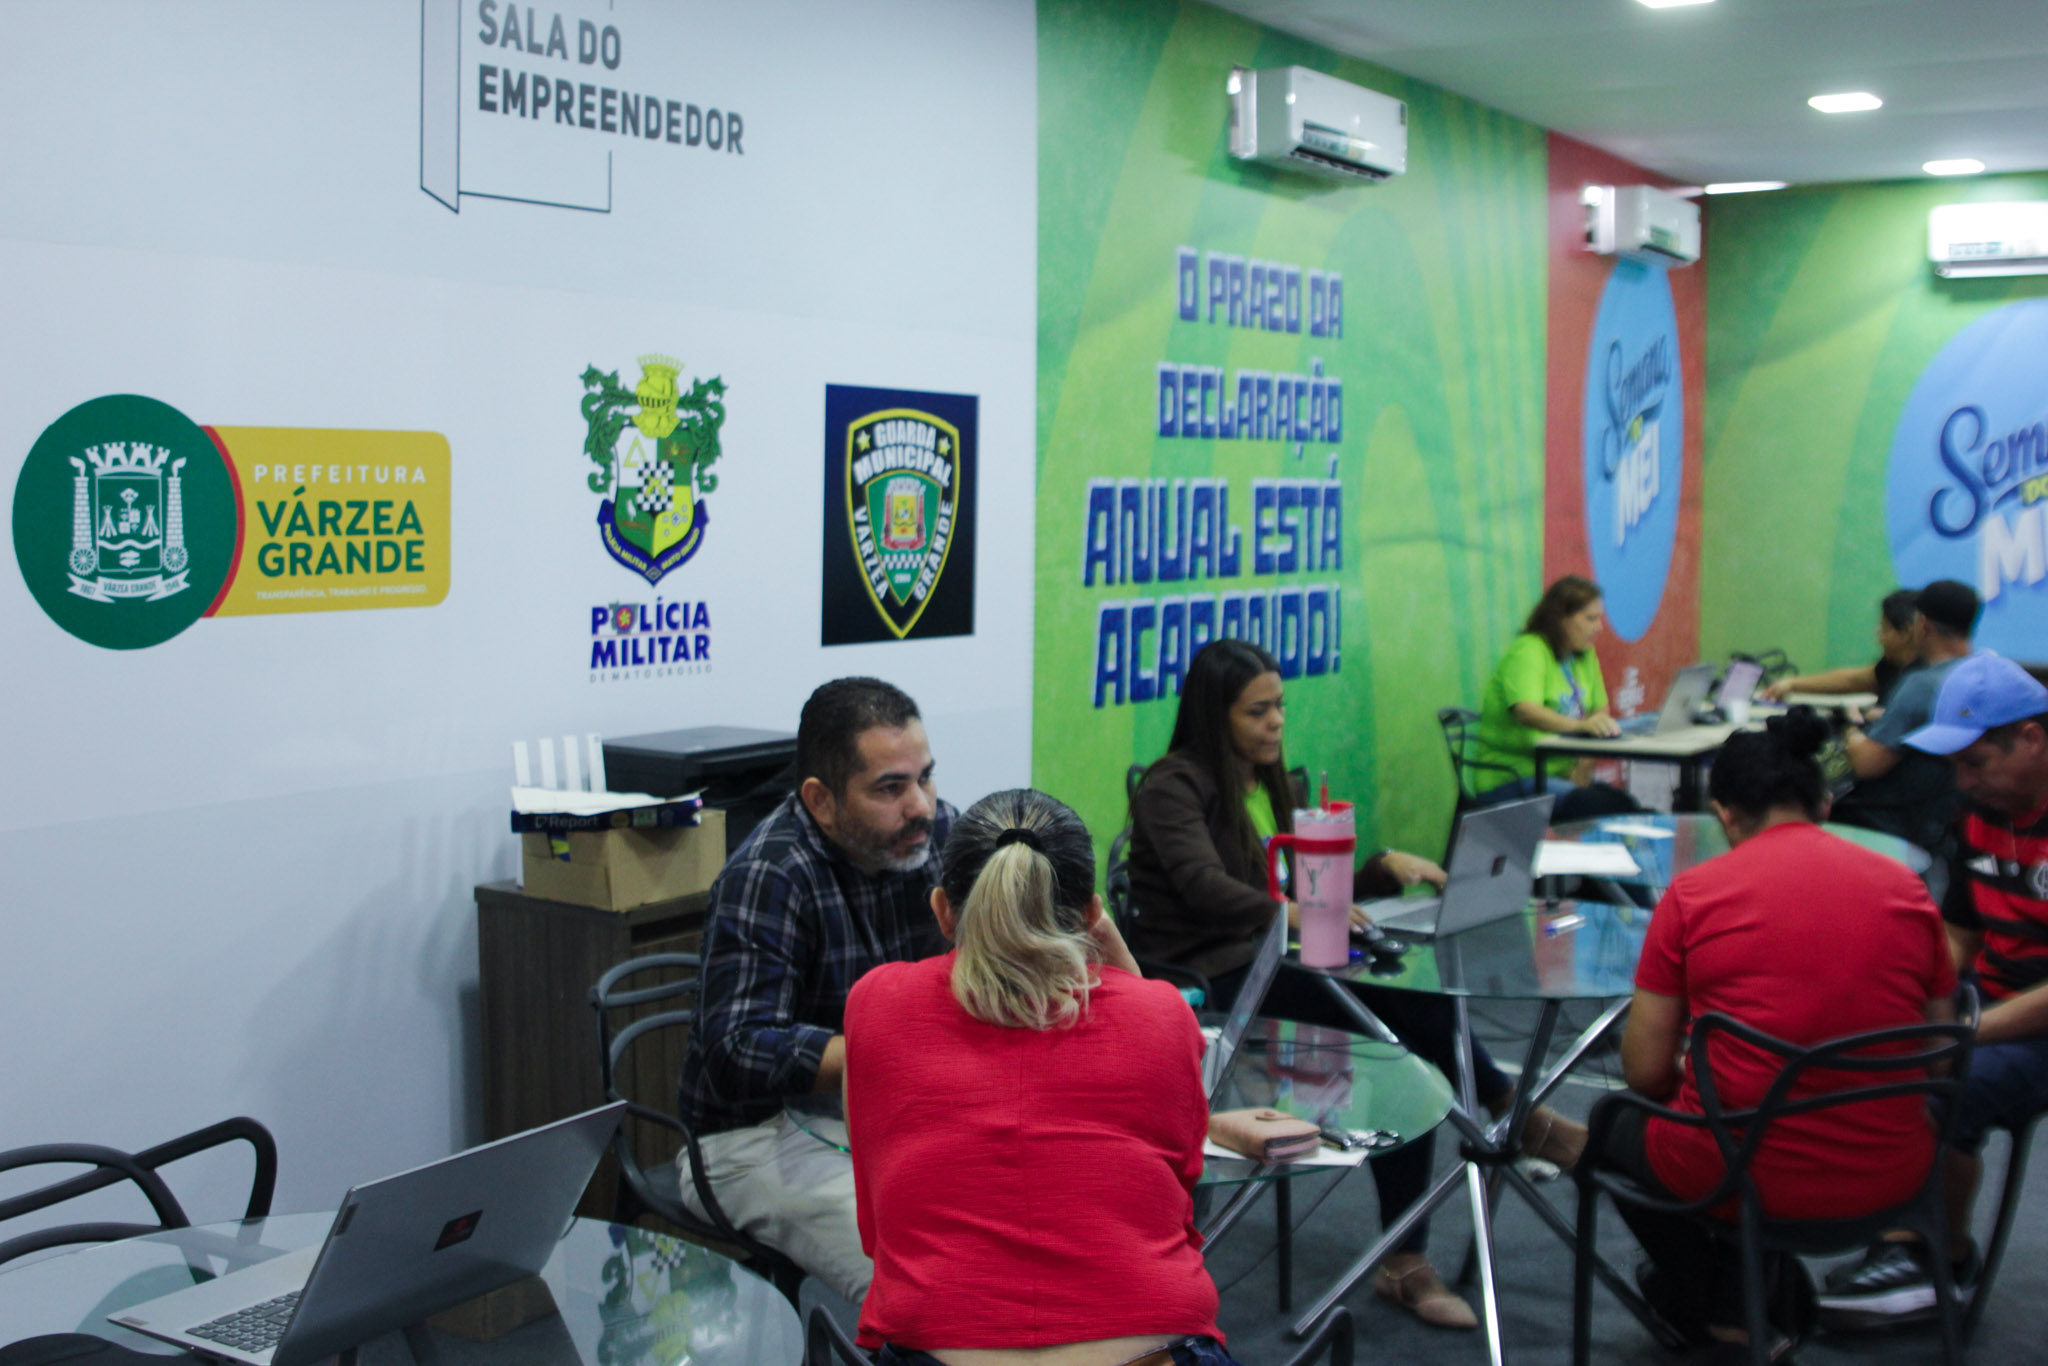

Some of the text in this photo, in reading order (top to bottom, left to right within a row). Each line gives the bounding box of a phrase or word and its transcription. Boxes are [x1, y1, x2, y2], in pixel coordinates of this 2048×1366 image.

[478, 0, 622, 71] SALA DO
[478, 63, 745, 155] EMPREENDEDOR
[1177, 246, 1343, 340] O PRAZO DA
[874, 420, 937, 451] GUARDA
[1157, 357, 1343, 460] DECLARAÇÃO
[254, 463, 427, 484] PREFEITURA
[853, 445, 953, 488] MUNICIPAL
[1615, 418, 1661, 548] MEI
[1930, 406, 2048, 539] Sem
[256, 485, 424, 538] VÁRZEA
[914, 500, 954, 601] GRANDE
[1084, 453, 1343, 587] ANUAL ESTÁ
[257, 540, 426, 578] GRANDE
[1984, 505, 2048, 603] M
[589, 664, 713, 684] DE MATO GROSSO
[590, 634, 711, 669] MILITAR
